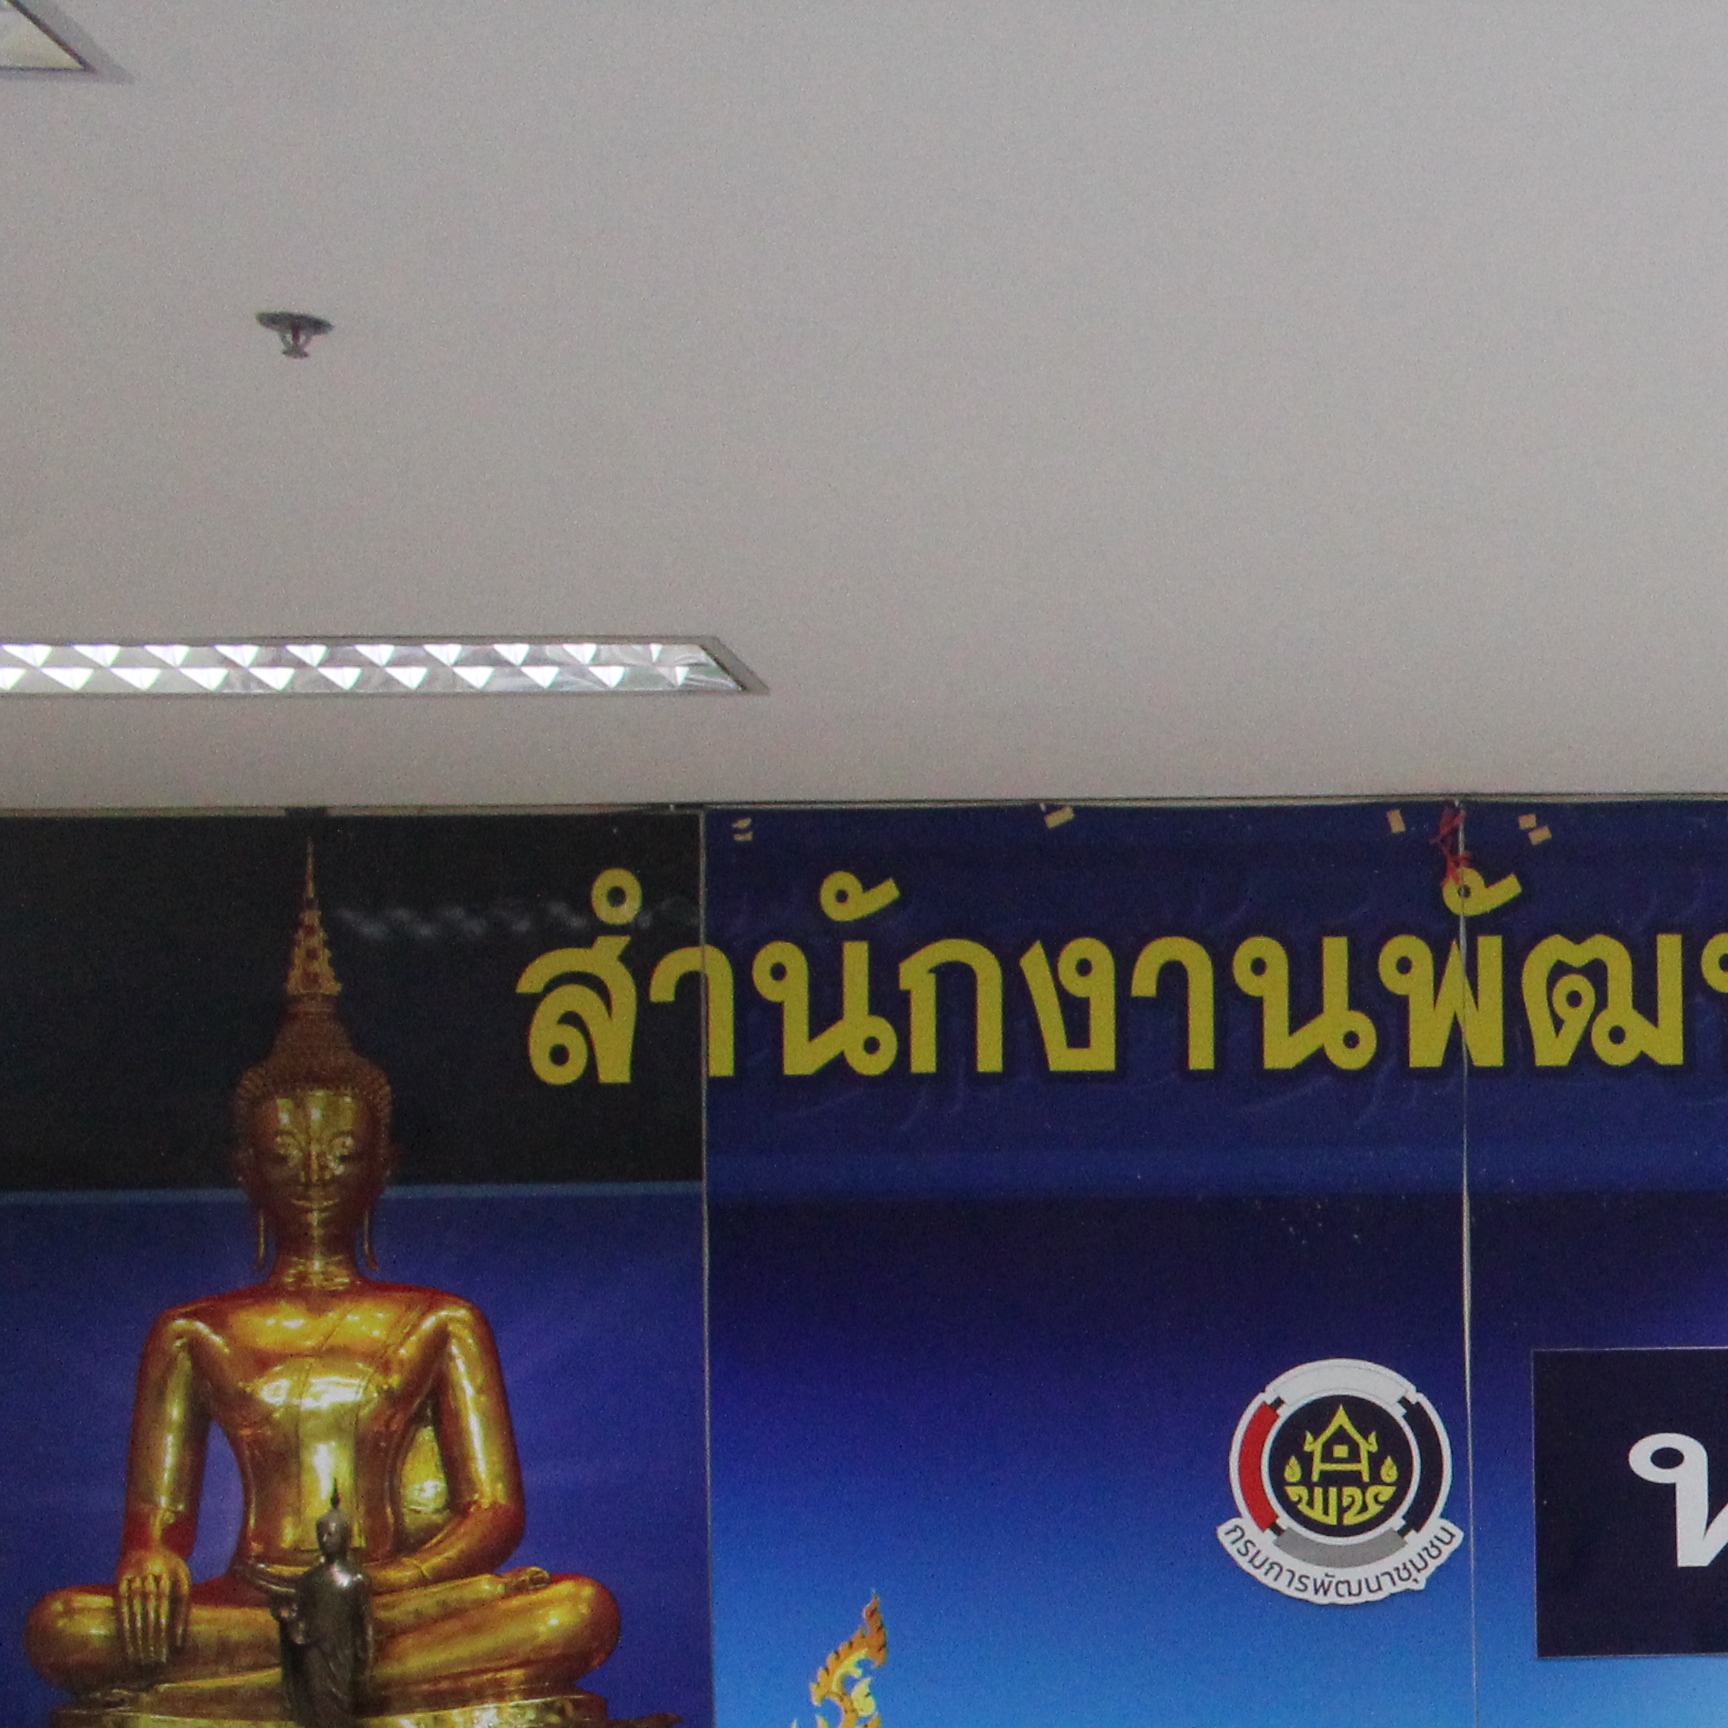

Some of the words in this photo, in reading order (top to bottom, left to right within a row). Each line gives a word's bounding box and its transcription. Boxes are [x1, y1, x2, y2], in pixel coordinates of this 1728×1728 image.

[1223, 1523, 1457, 1598] กรมการพัฒนาชุมชน
